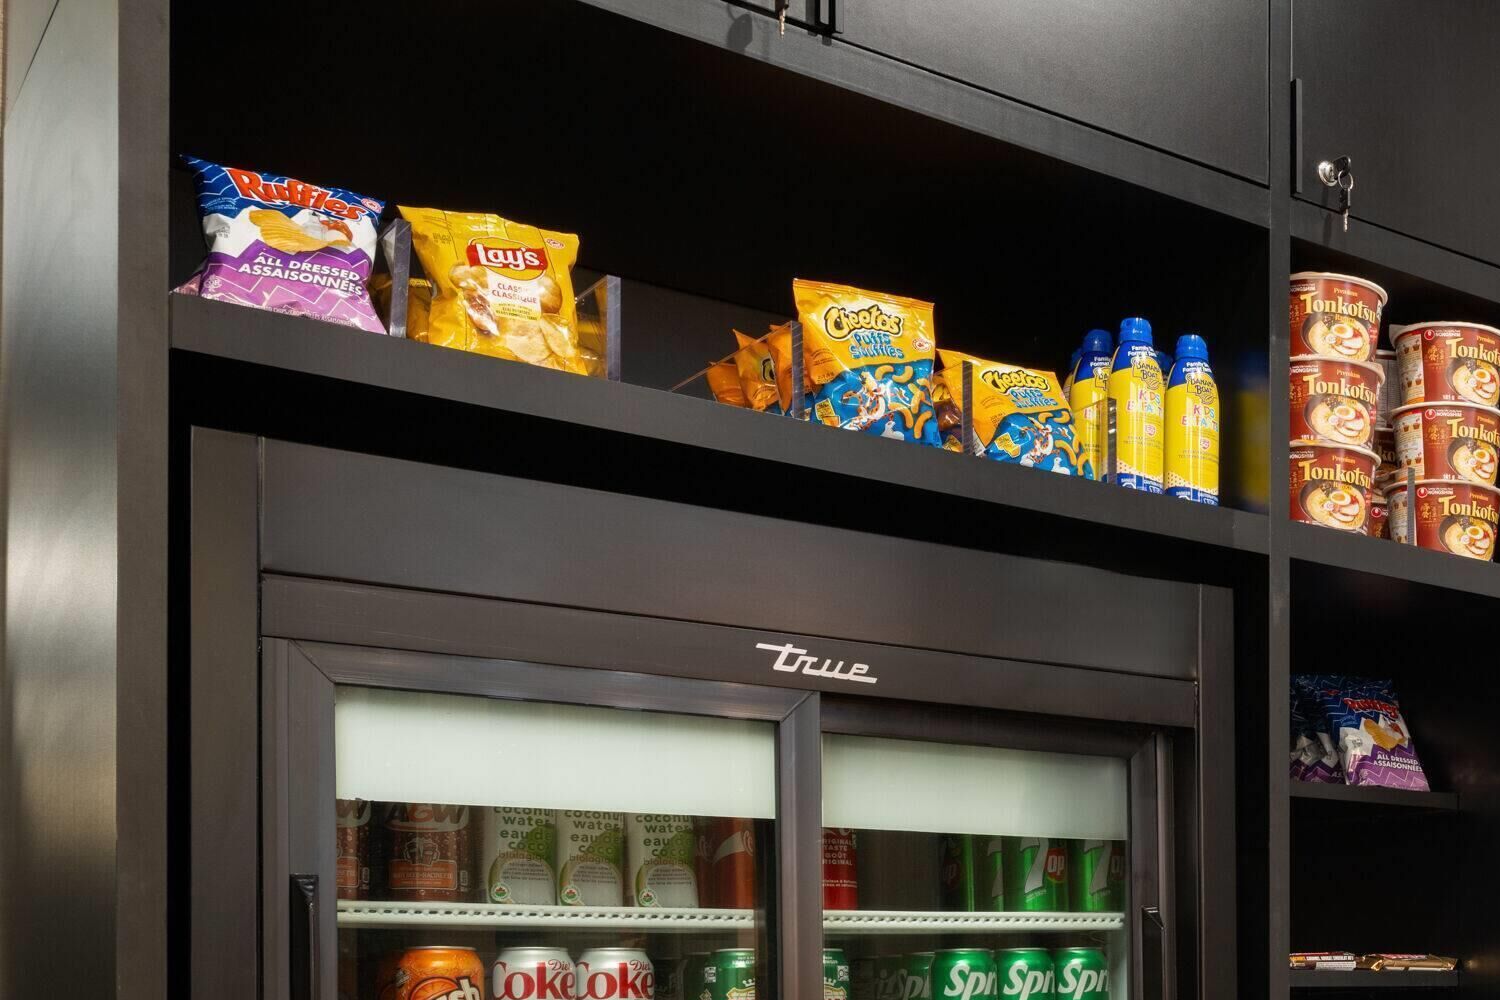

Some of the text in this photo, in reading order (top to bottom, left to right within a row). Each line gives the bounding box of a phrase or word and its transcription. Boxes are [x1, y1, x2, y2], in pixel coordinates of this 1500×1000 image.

[224, 167, 370, 221] Ruffles
[475, 243, 540, 270] Lay's
[253, 255, 360, 281] ALL DRESSED
[238, 263, 363, 297] ASSAISONNÉES
[497, 282, 529, 294] CLASS
[1334, 288, 1358, 297] Premium
[1301, 291, 1377, 324] Tonkotsu
[825, 304, 901, 339] Cheetos
[853, 332, 891, 346] Puffs
[981, 370, 1050, 394] Cheetos
[1303, 373, 1377, 404] Tonkotsu
[1140, 389, 1161, 405] KDS
[1194, 405, 1215, 419] KDS
[1298, 459, 1371, 489] Tonkotsu
[756, 643, 877, 683] true
[1391, 755, 1419, 765] DRESSED
[494, 806, 553, 818] coconu
[564, 810, 624, 821] coconu
[503, 815, 550, 826] water
[574, 820, 619, 831] water
[635, 814, 692, 824] coconu
[500, 829, 530, 840] eau
[645, 823, 690, 834] water
[571, 833, 598, 843] eau
[643, 837, 670, 847] eau
[508, 840, 545, 850] coco
[578, 844, 617, 854] coco
[652, 848, 689, 858] coco
[575, 961, 655, 1000] Coke
[1058, 961, 1109, 1000] Spr
